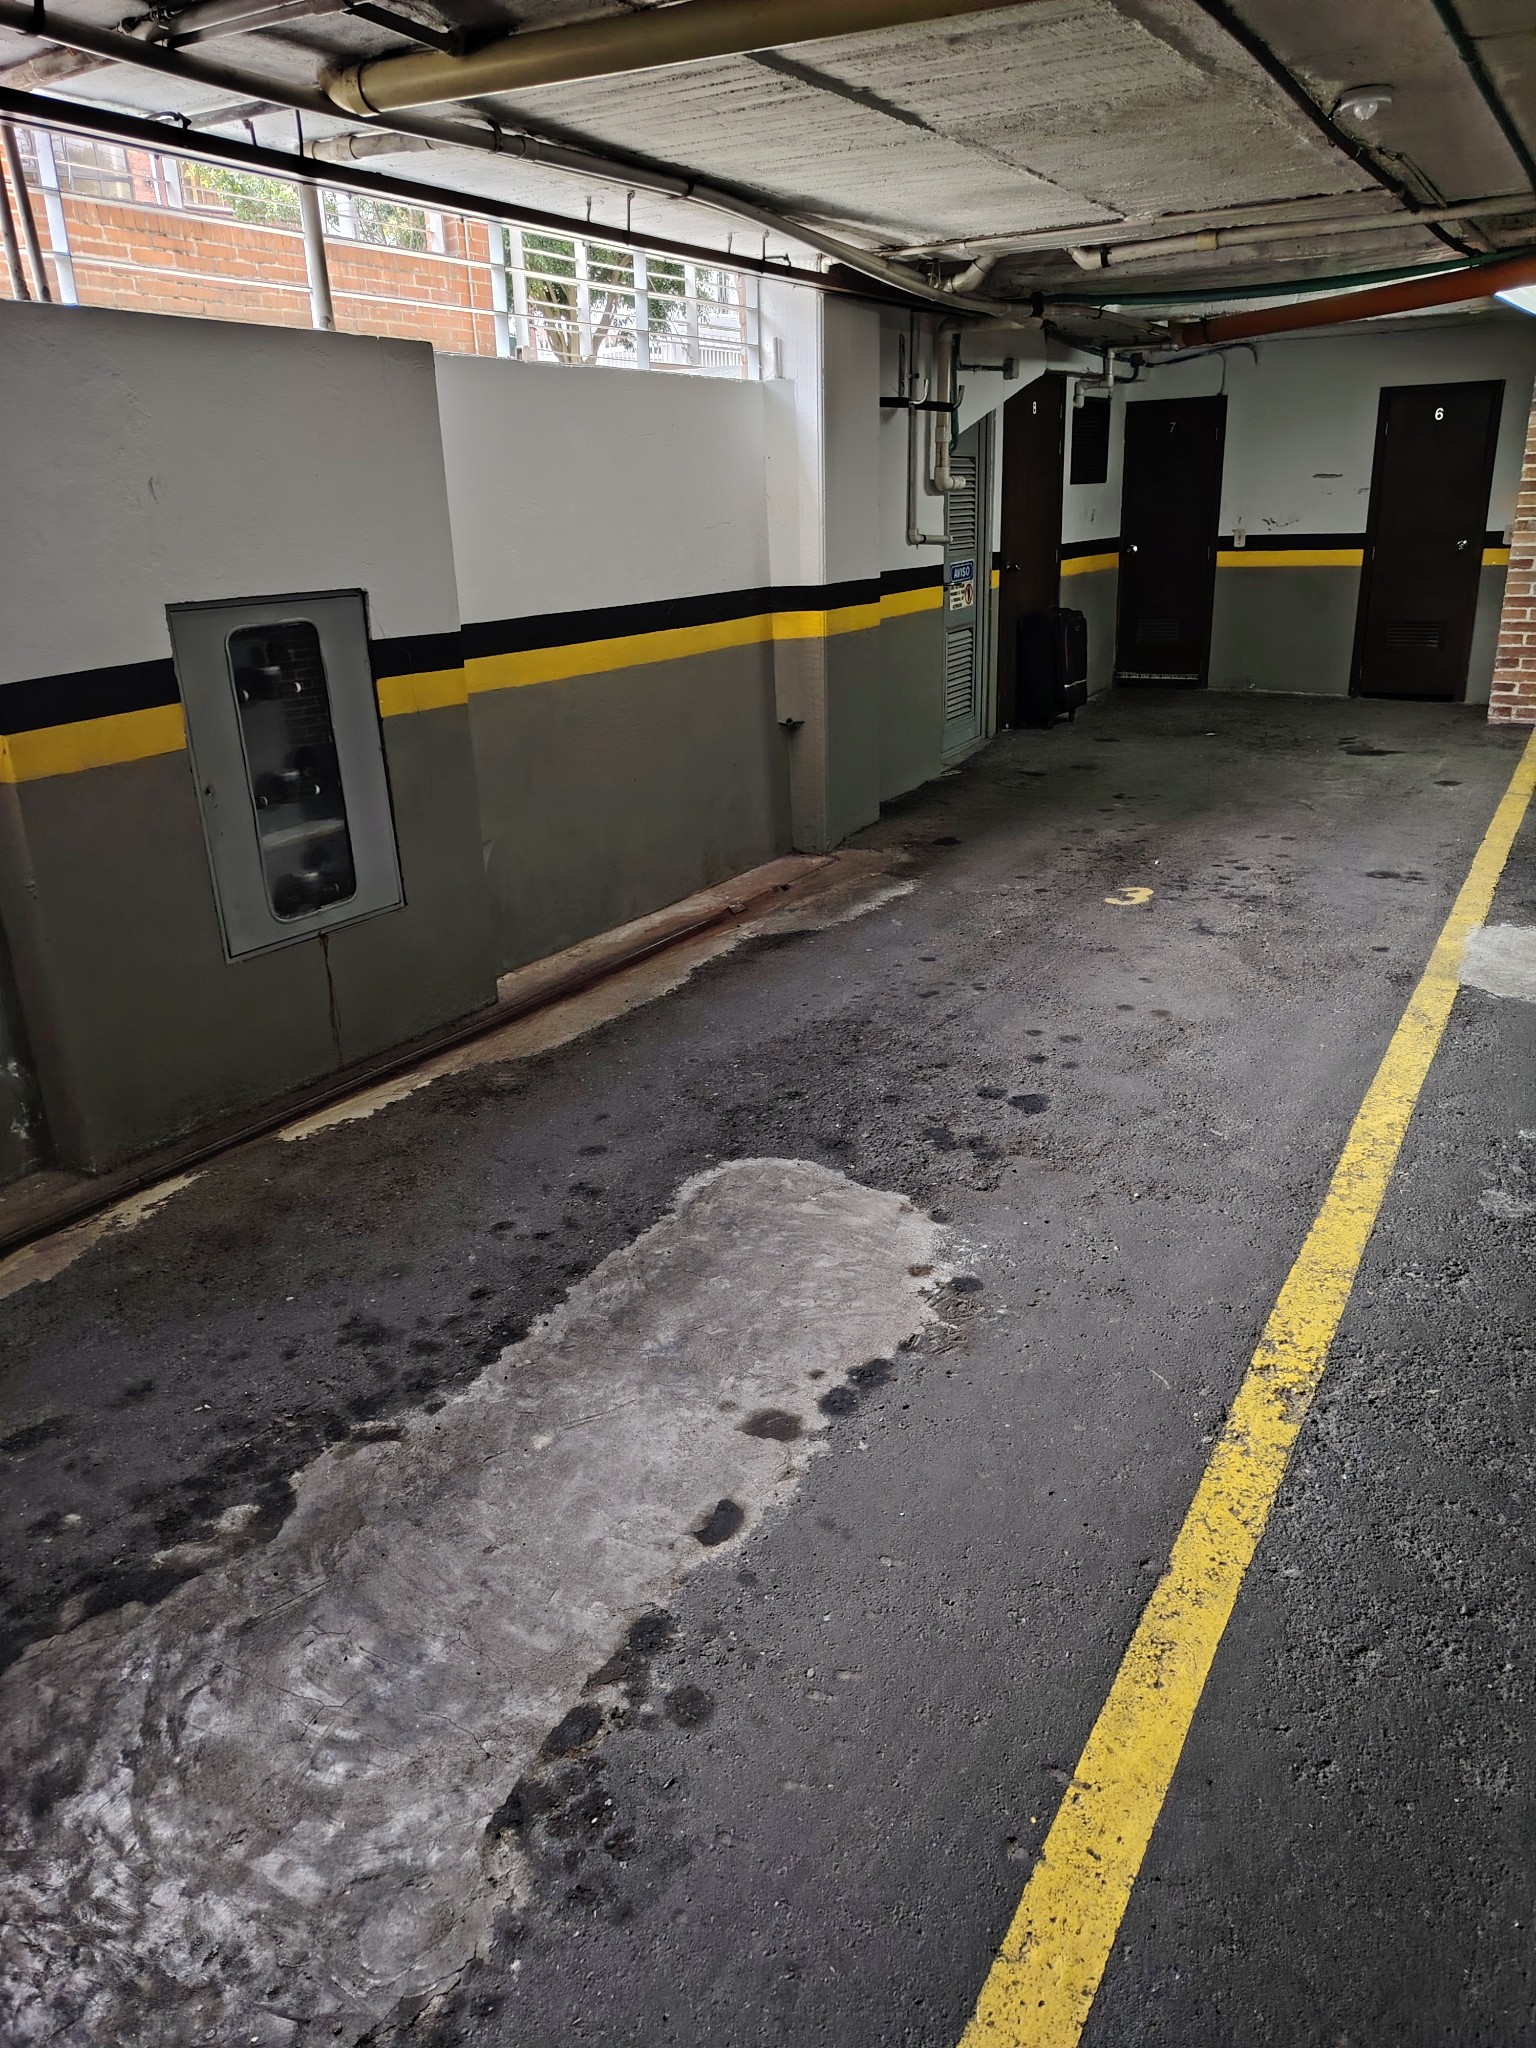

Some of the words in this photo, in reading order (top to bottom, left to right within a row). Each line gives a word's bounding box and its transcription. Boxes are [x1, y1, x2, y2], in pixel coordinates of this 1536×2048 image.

[1032, 400, 1037, 415] 8
[1434, 407, 1444, 421] 6
[1169, 421, 1176, 433] 7
[953, 565, 971, 580] AVISO
[1104, 886, 1154, 905] 3
